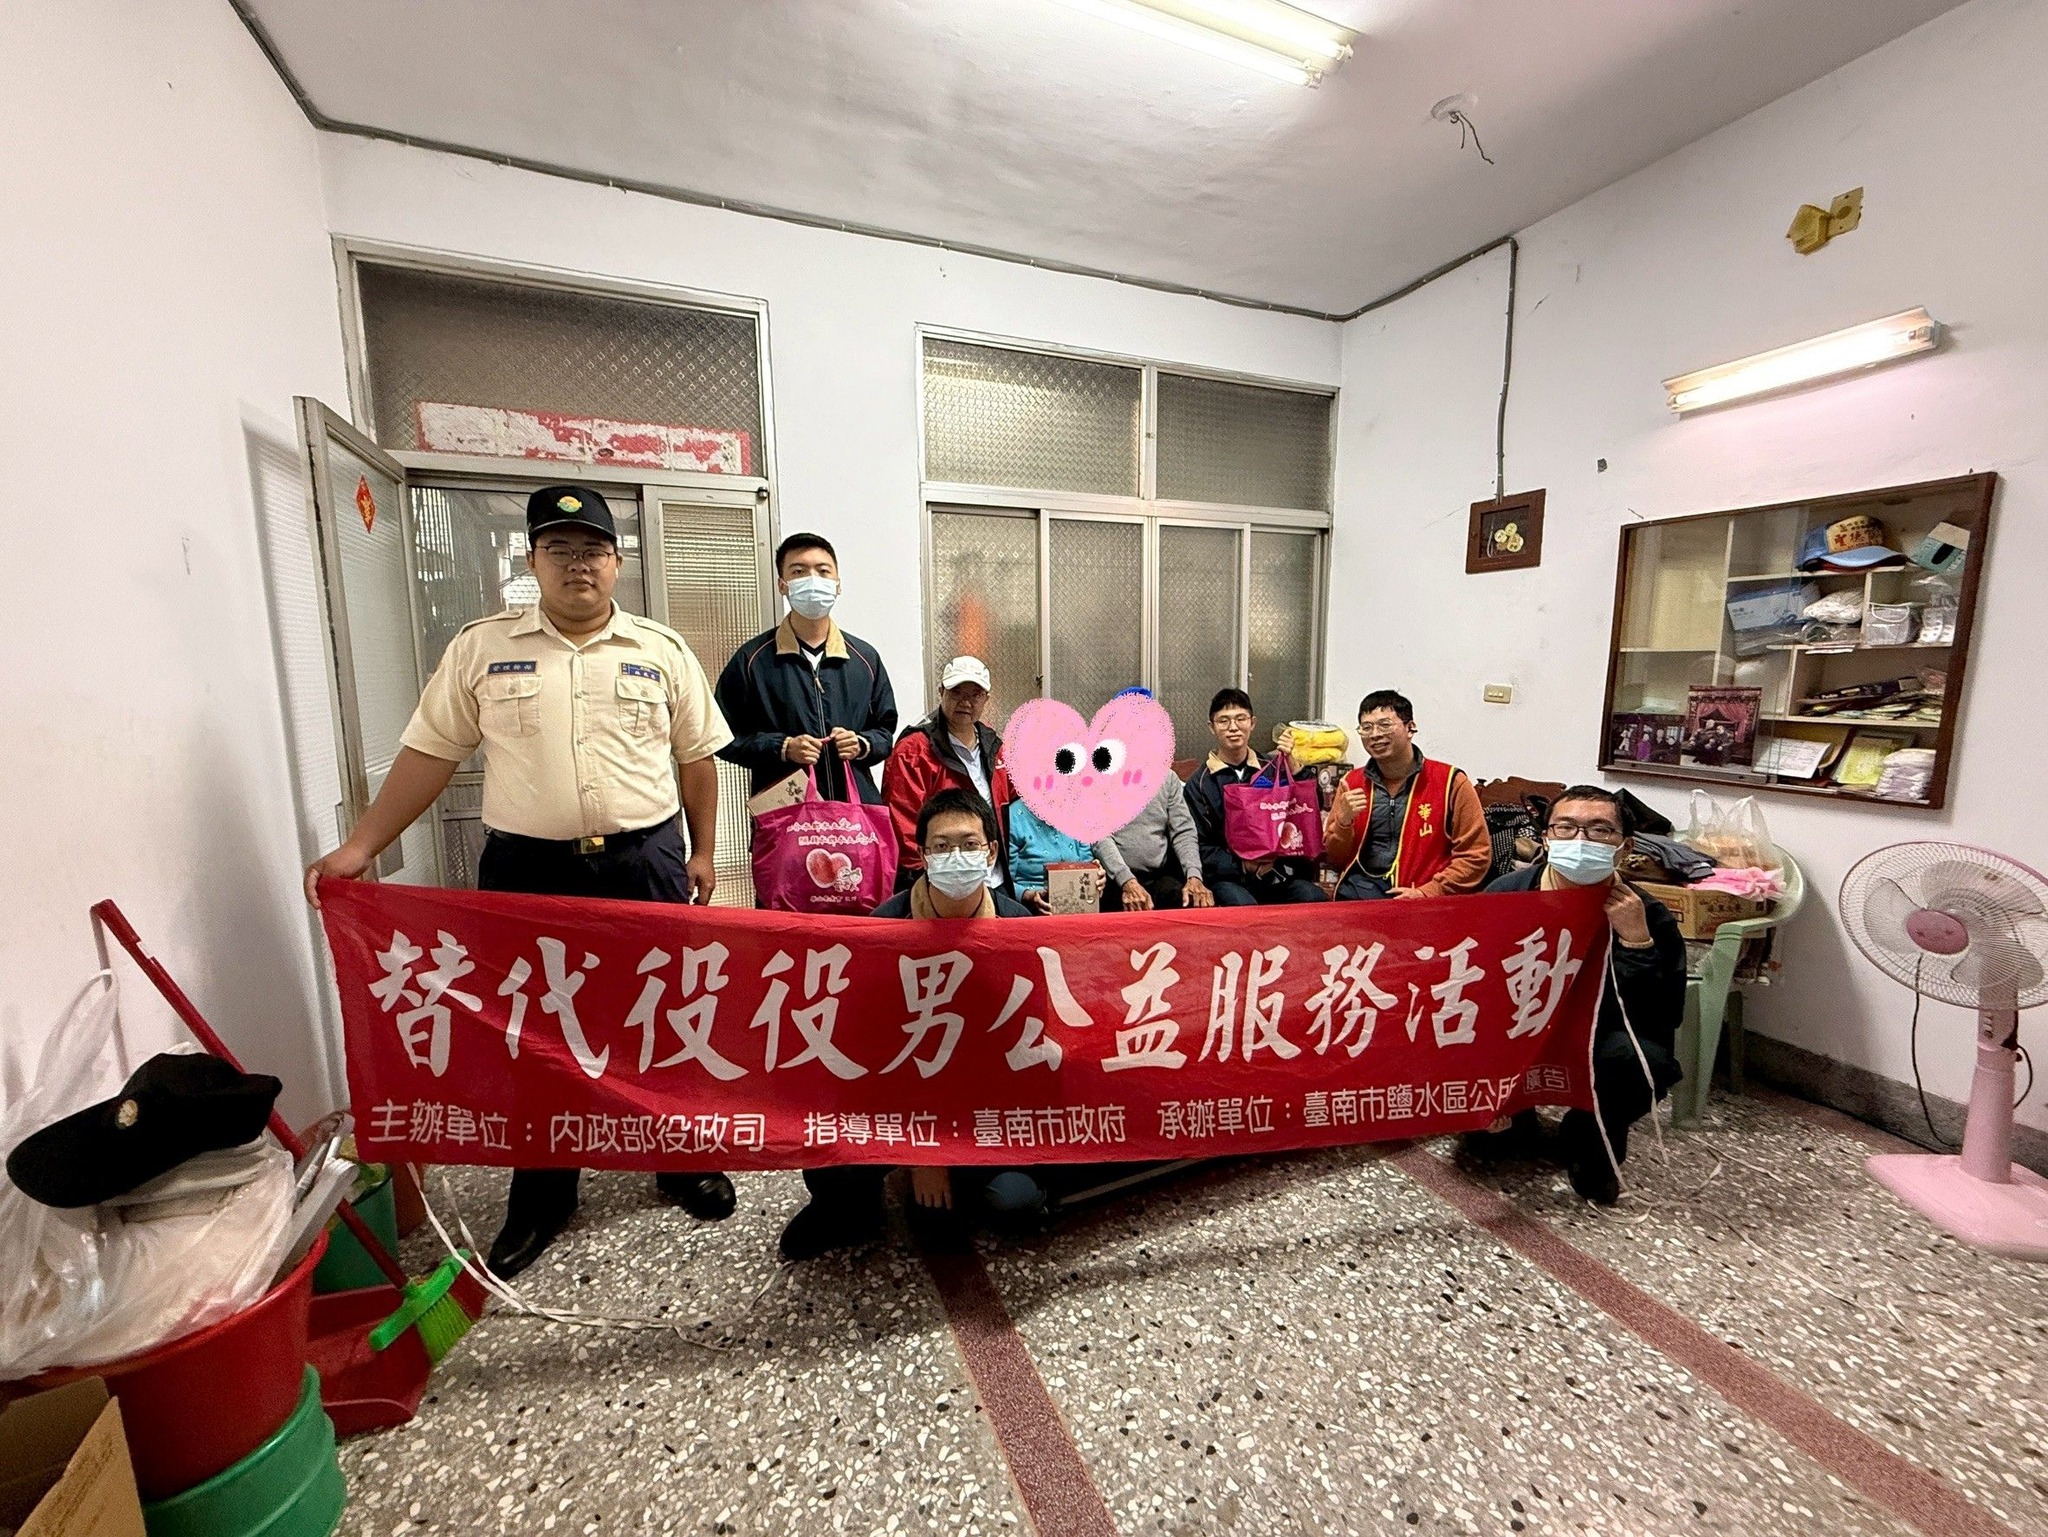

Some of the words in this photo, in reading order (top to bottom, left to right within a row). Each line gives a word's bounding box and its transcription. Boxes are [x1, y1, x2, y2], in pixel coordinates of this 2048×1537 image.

[1417, 802, 1433, 838] 華山
[368, 926, 1583, 1081] 替代役役男公益服務活動
[1526, 1067, 1566, 1090] 廣告
